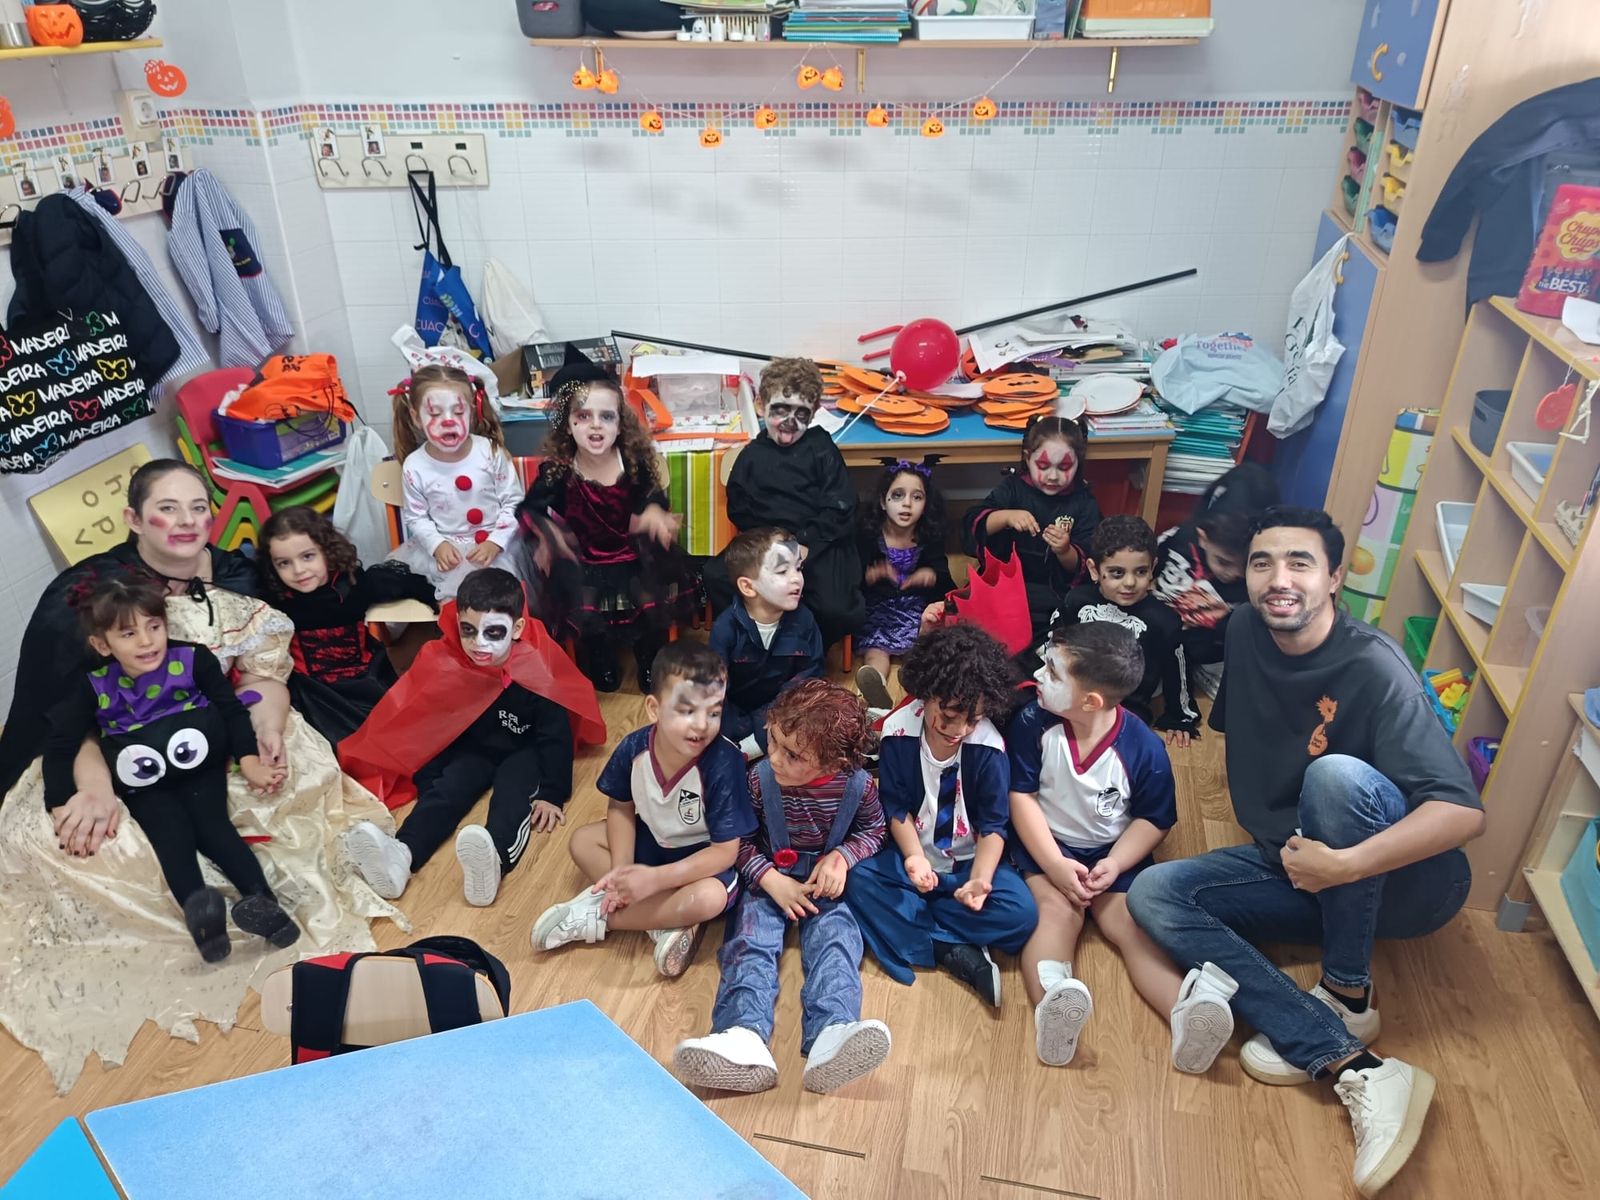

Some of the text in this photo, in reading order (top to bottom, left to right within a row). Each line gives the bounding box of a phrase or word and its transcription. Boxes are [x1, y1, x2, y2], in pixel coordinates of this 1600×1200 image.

[1549, 277, 1588, 294] BEST
[0, 362, 48, 393] DEIRA
[37, 369, 103, 404] MADEIRA
[97, 378, 146, 410] MADEIR
[59, 414, 121, 447] MADEIRA
